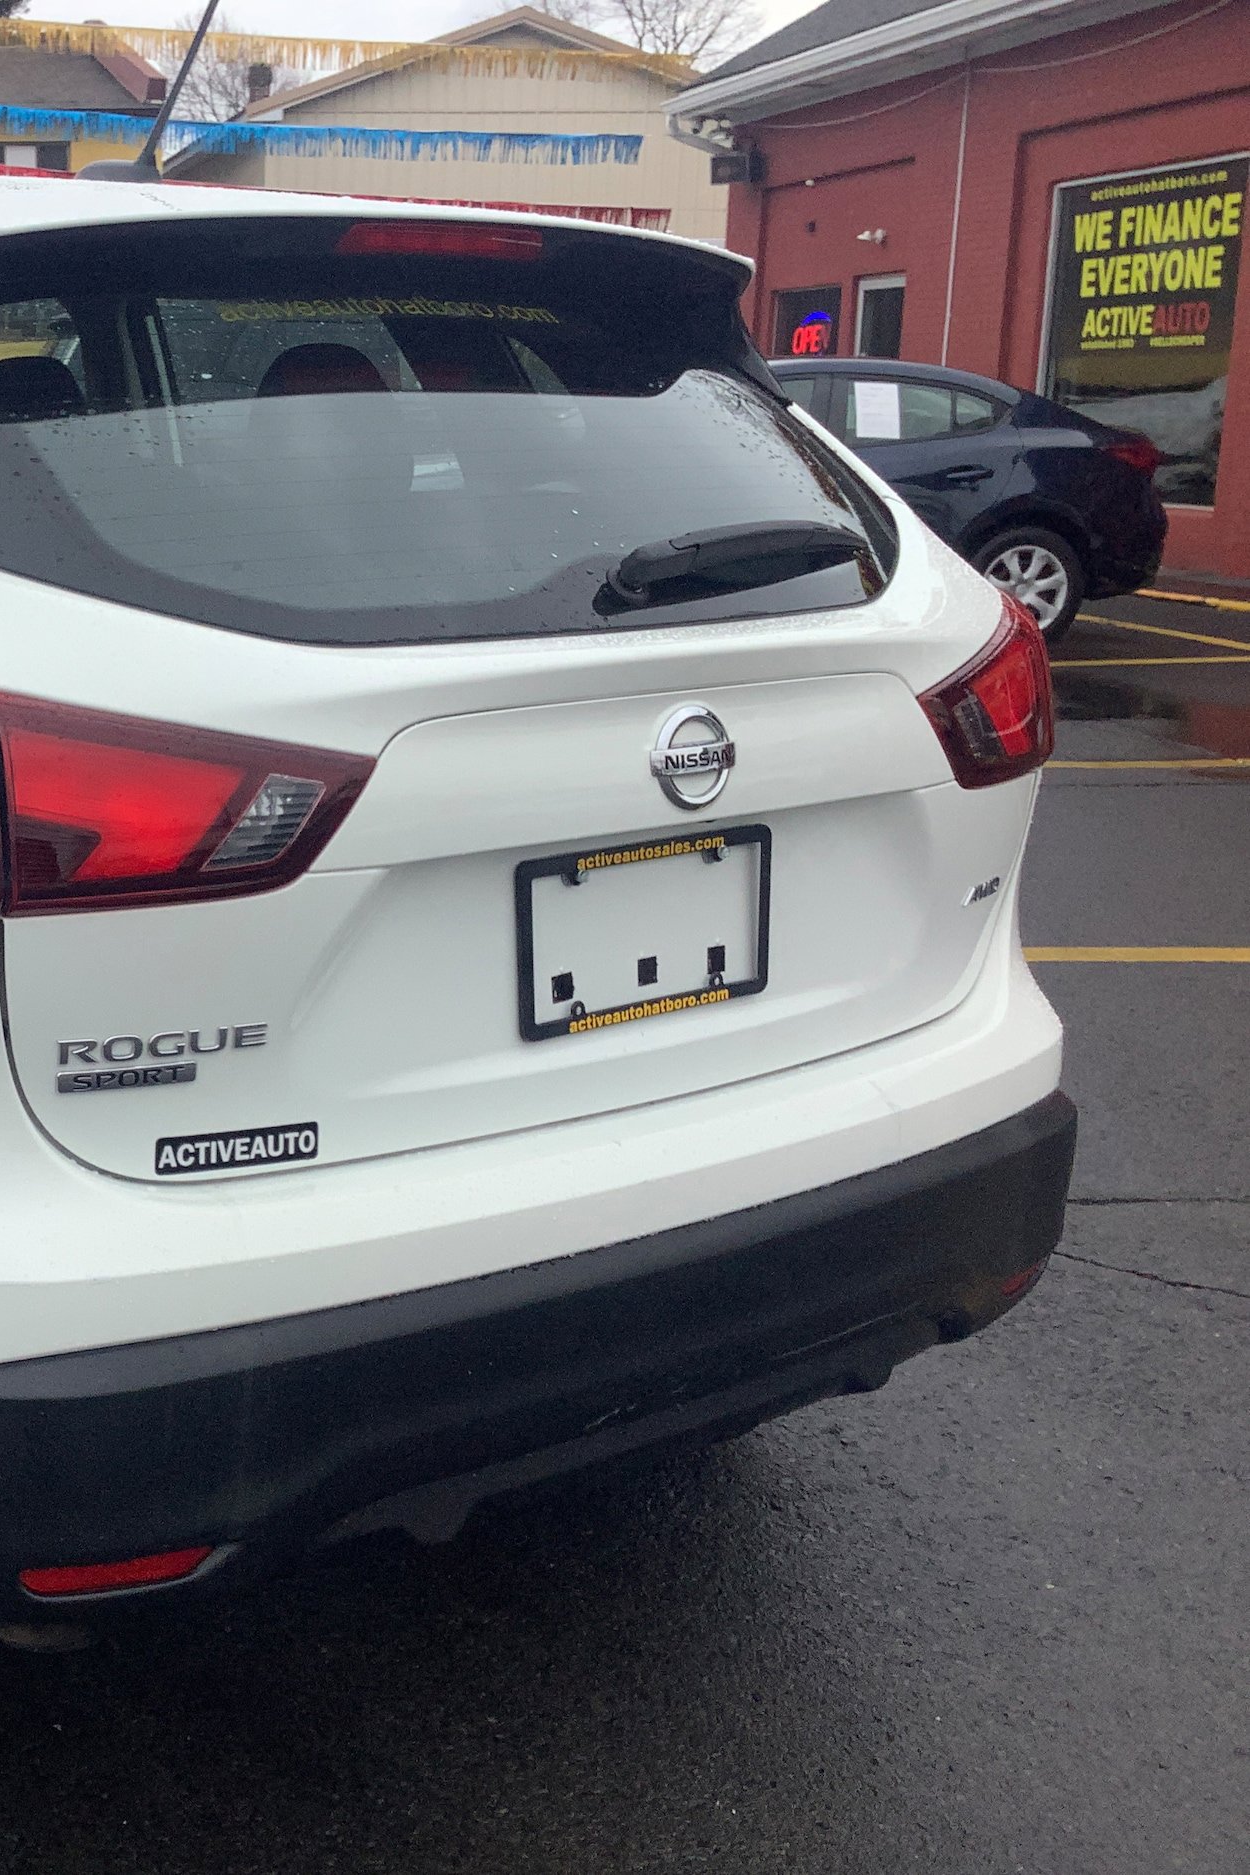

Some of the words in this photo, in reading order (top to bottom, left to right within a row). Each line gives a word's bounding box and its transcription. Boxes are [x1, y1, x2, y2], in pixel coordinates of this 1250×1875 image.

[1074, 209, 1114, 254] WE
[1118, 191, 1243, 249] FINANCE
[1079, 244, 1226, 298] EVERYONE
[664, 748, 733, 771] NISSAN
[576, 834, 725, 872] activeautosales.com
[569, 987, 730, 1034] activeautohatboro.com
[56, 1021, 269, 1066] ROGUE
[72, 1066, 186, 1092] SPORT
[157, 1129, 317, 1170] ACTIVEAUTO
